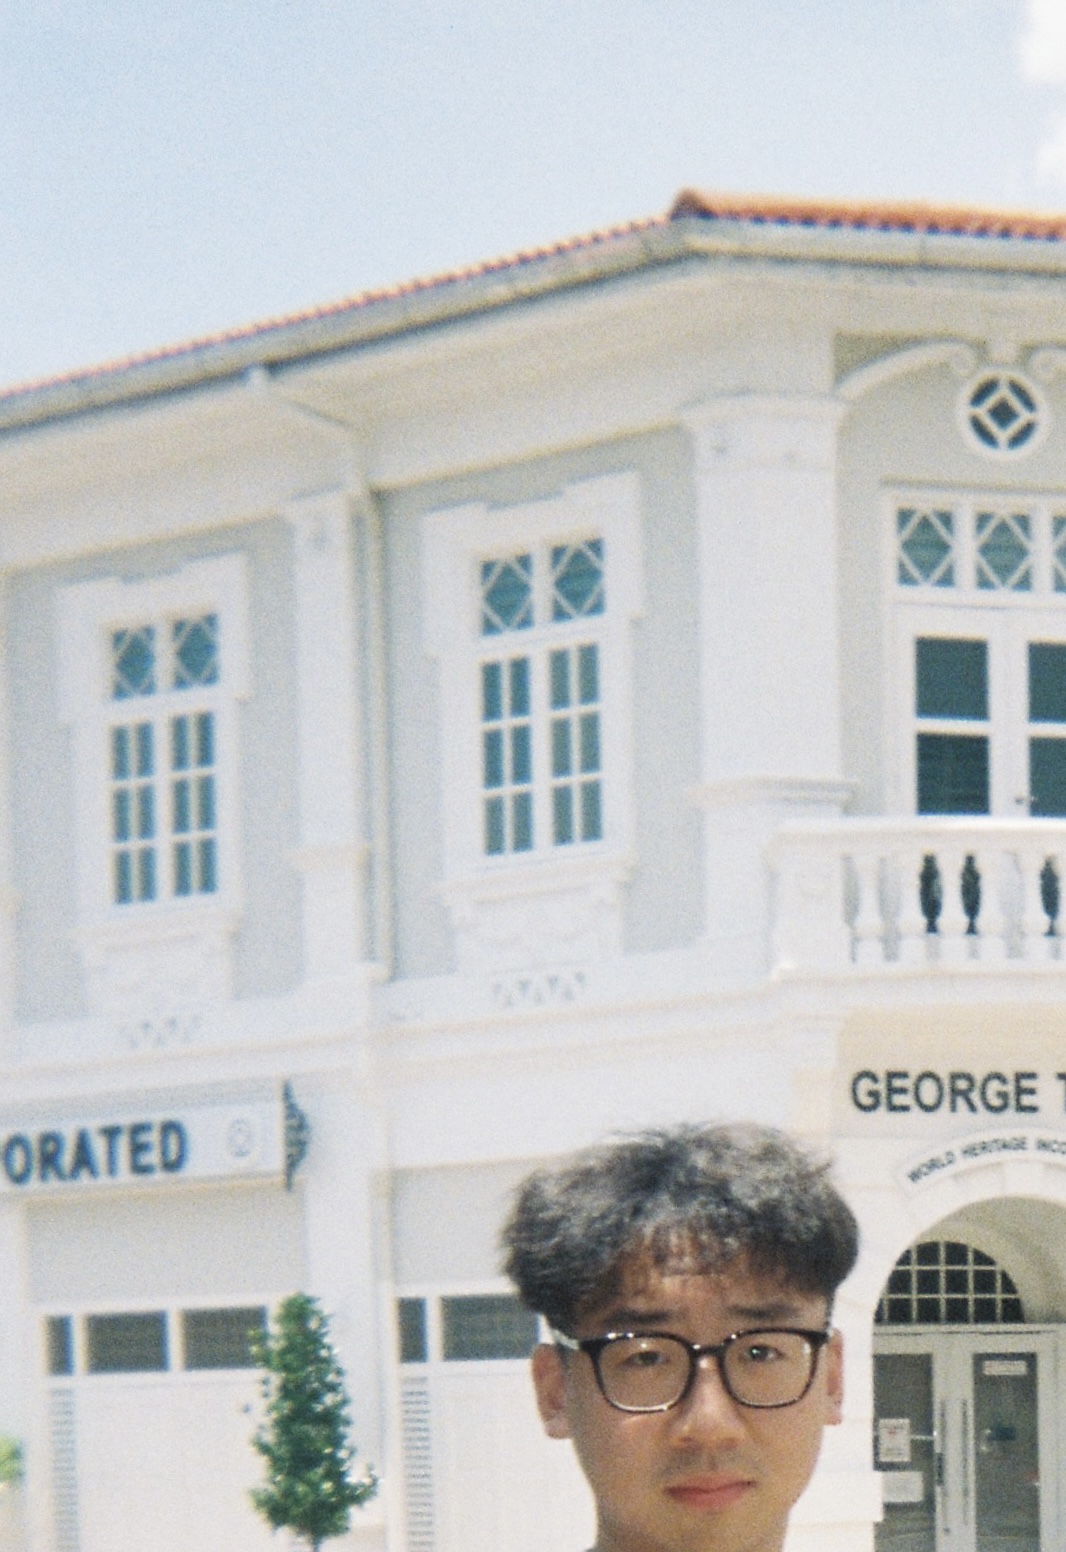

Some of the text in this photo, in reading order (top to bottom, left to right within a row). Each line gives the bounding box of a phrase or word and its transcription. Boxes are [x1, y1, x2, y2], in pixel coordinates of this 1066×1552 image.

[851, 1070, 1038, 1113] GEORGE
[4, 1119, 188, 1185] ORATED
[908, 1151, 955, 1183] WORLD
[962, 1136, 1027, 1158] HERITAGE
